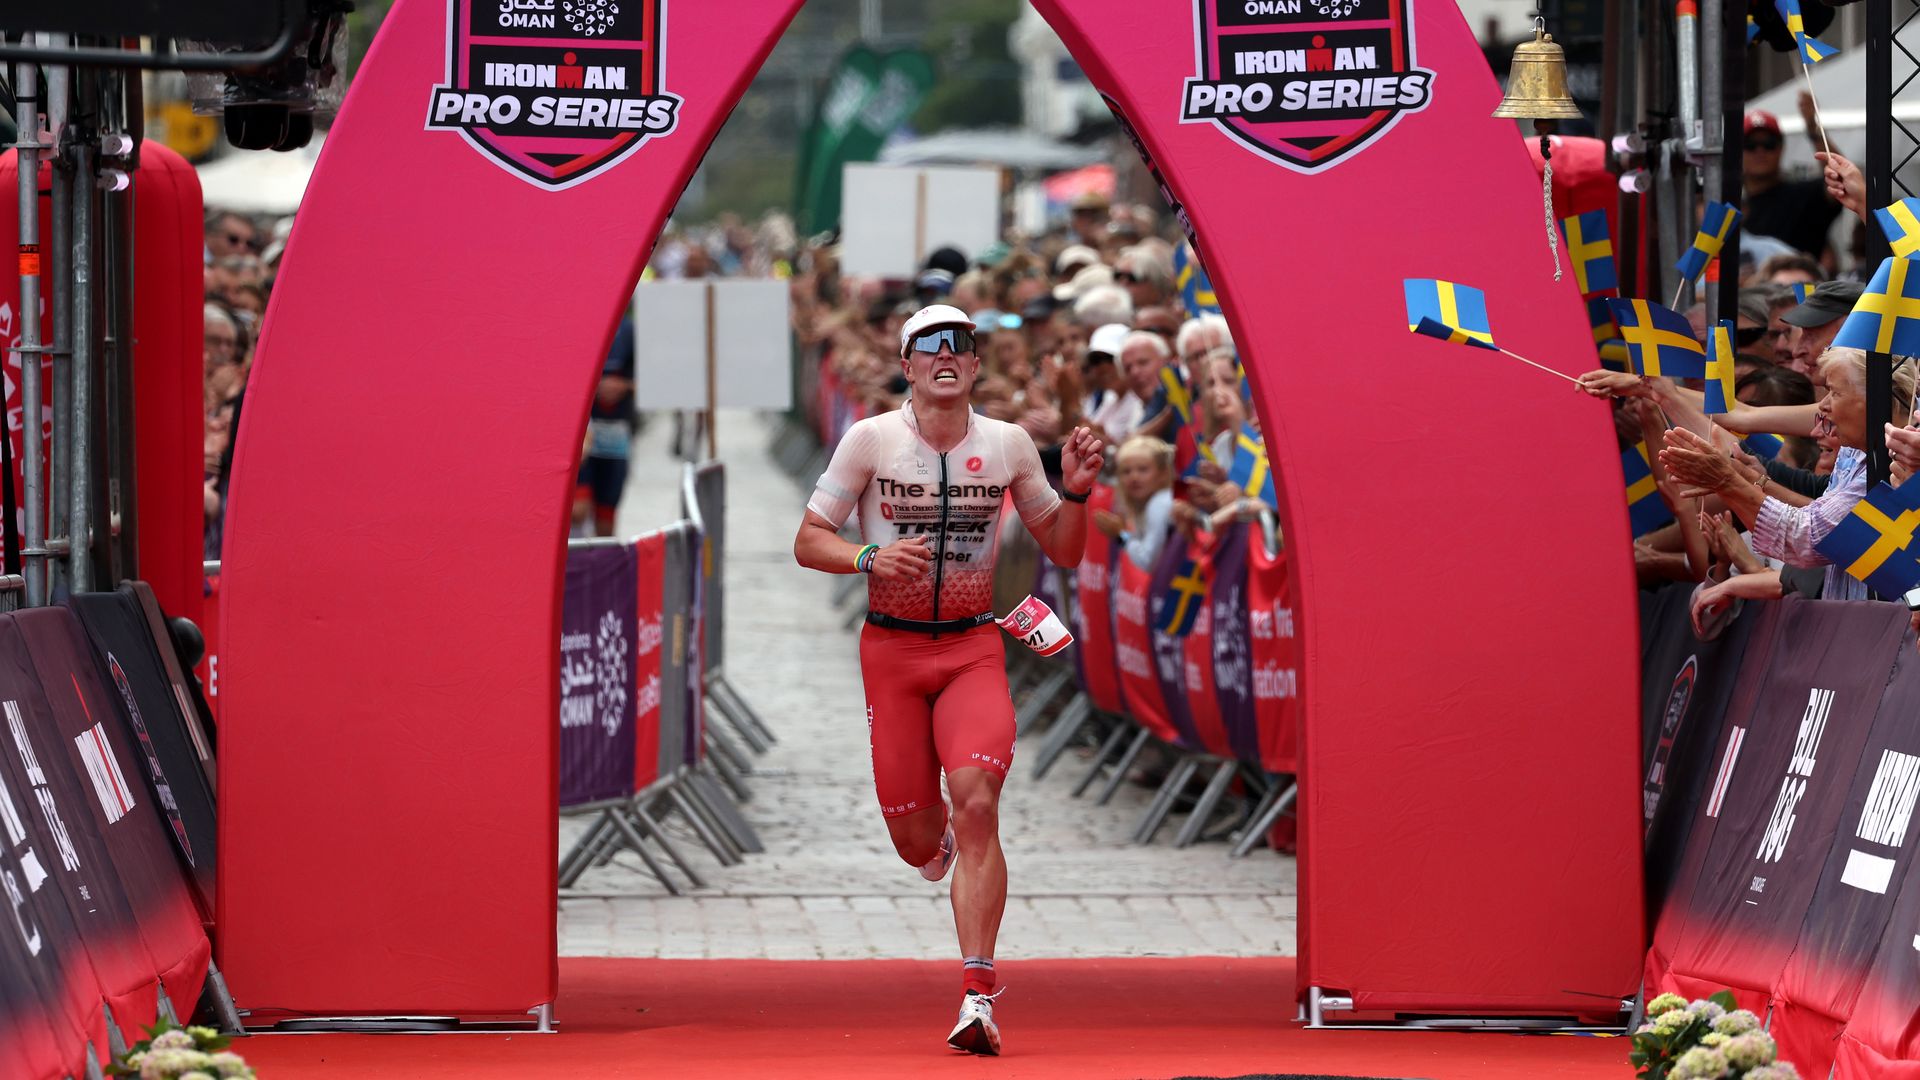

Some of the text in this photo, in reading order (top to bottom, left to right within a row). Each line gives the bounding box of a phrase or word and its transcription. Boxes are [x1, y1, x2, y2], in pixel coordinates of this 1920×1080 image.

[499, 13, 555, 28] OMAN
[1245, 0, 1301, 15] OMAN
[1235, 36, 1376, 75] IRONMAN
[485, 53, 626, 89] IRONMAN
[1189, 75, 1427, 114] PRO SERIES
[434, 93, 673, 129] PRO SERIES
[877, 478, 925, 498] The
[893, 521, 991, 534] TREK
